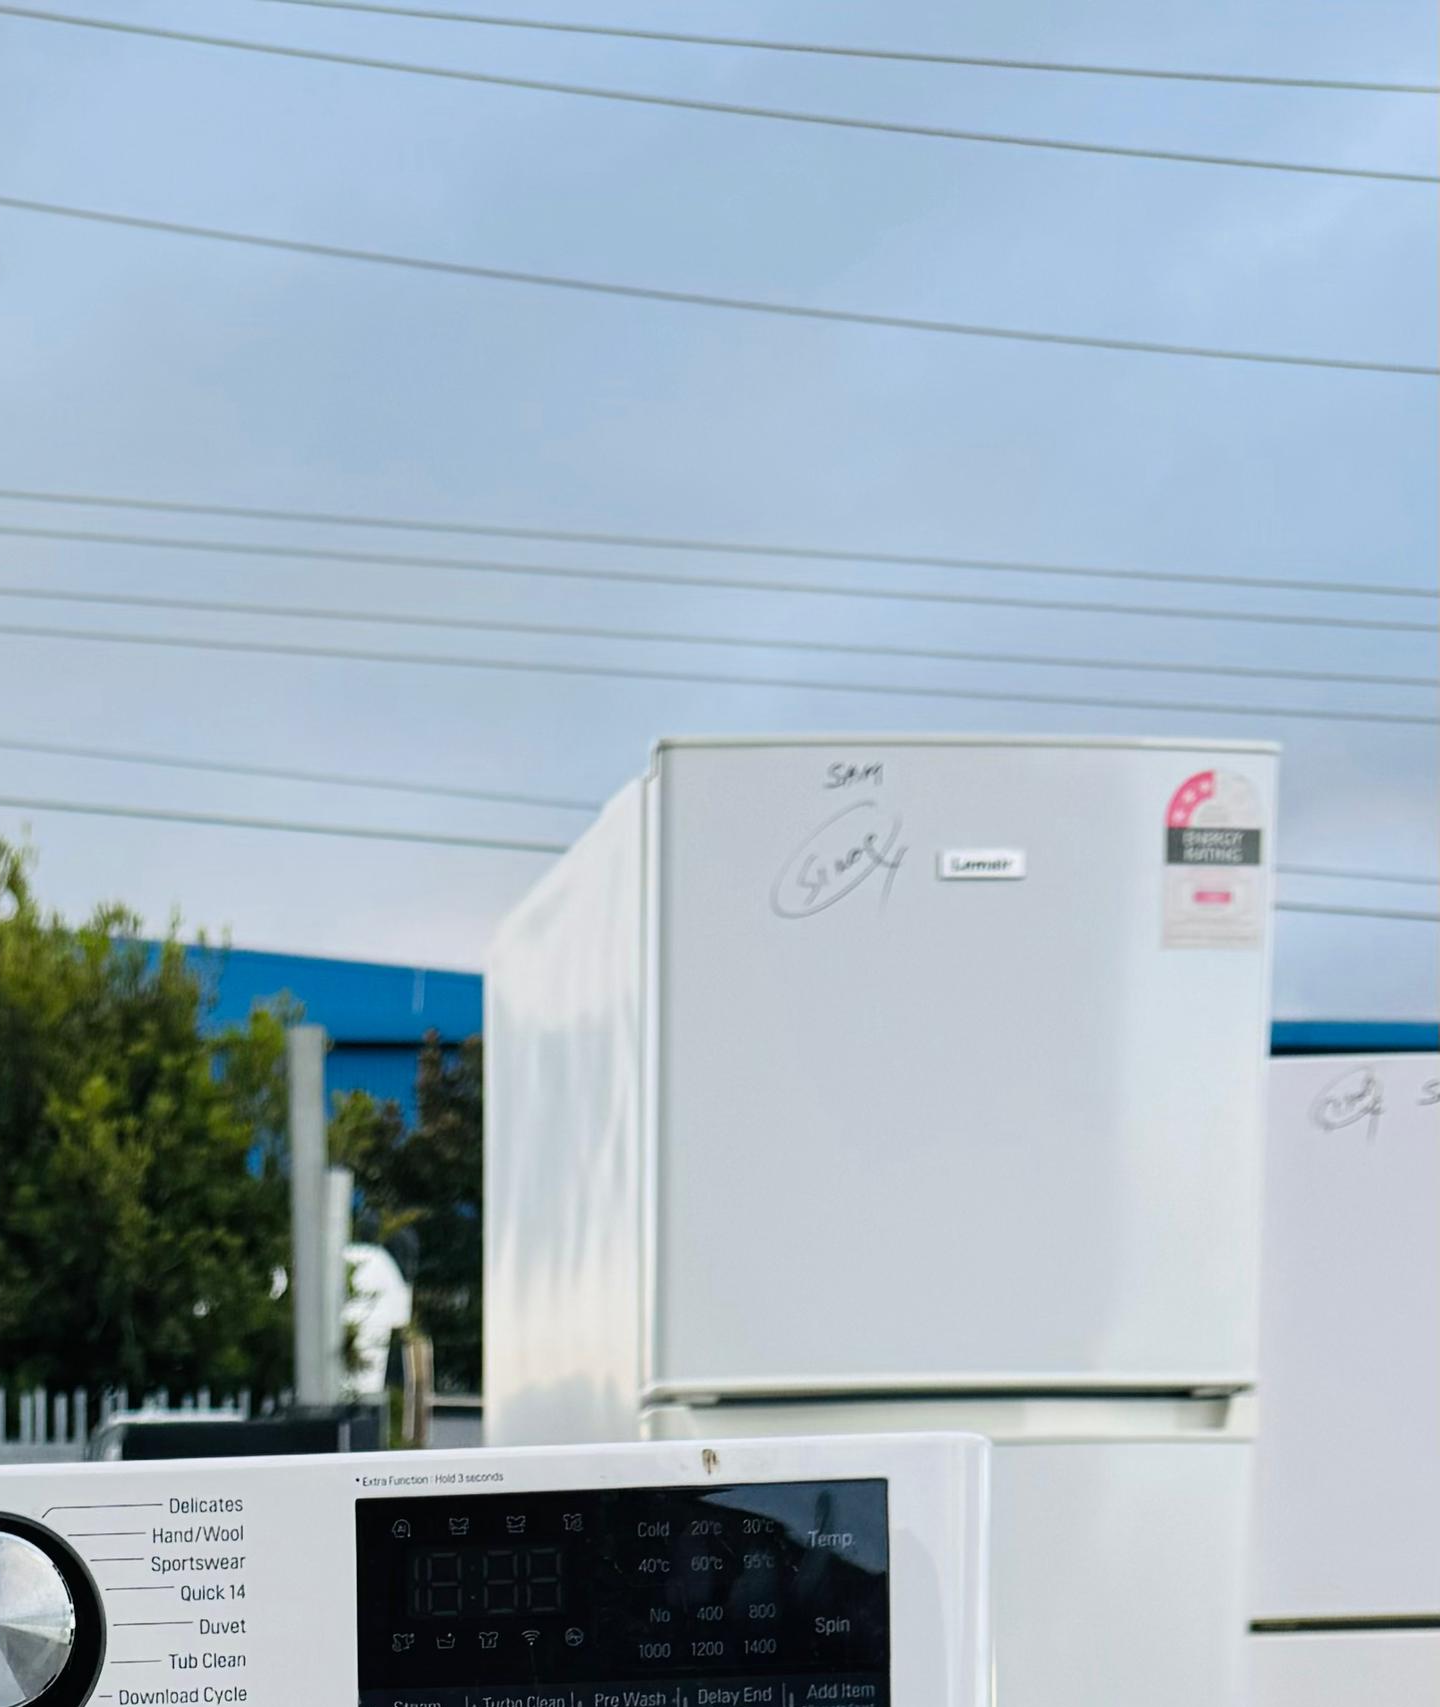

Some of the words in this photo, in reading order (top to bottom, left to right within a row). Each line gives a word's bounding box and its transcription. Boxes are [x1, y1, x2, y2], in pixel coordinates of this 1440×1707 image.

[363, 1477, 387, 1487] Extra
[389, 1475, 428, 1486] Function
[169, 1497, 243, 1514] Delicates
[152, 1526, 244, 1545] Hand/Wool
[638, 1521, 670, 1538] Cold
[151, 1554, 246, 1574] Sportswear
[180, 1584, 225, 1602] Quick
[229, 1584, 246, 1599] 14
[649, 1608, 671, 1623] No
[697, 1606, 723, 1621] 400
[748, 1604, 776, 1619] 800
[199, 1618, 246, 1635] Duvet
[815, 1616, 850, 1636] Spin
[640, 1643, 671, 1658] 1000
[691, 1641, 723, 1657] 1200
[744, 1639, 776, 1655] 1400
[169, 1653, 197, 1670] Tub
[202, 1652, 246, 1669] Clean
[119, 1687, 199, 1706] Download
[203, 1686, 247, 1705] Cycle
[595, 1693, 620, 1707] Pre
[623, 1692, 666, 1707] Wash
[699, 1688, 741, 1706] Delay
[743, 1686, 772, 1702] End
[806, 1685, 839, 1700] Add
[841, 1683, 876, 1699] Item
